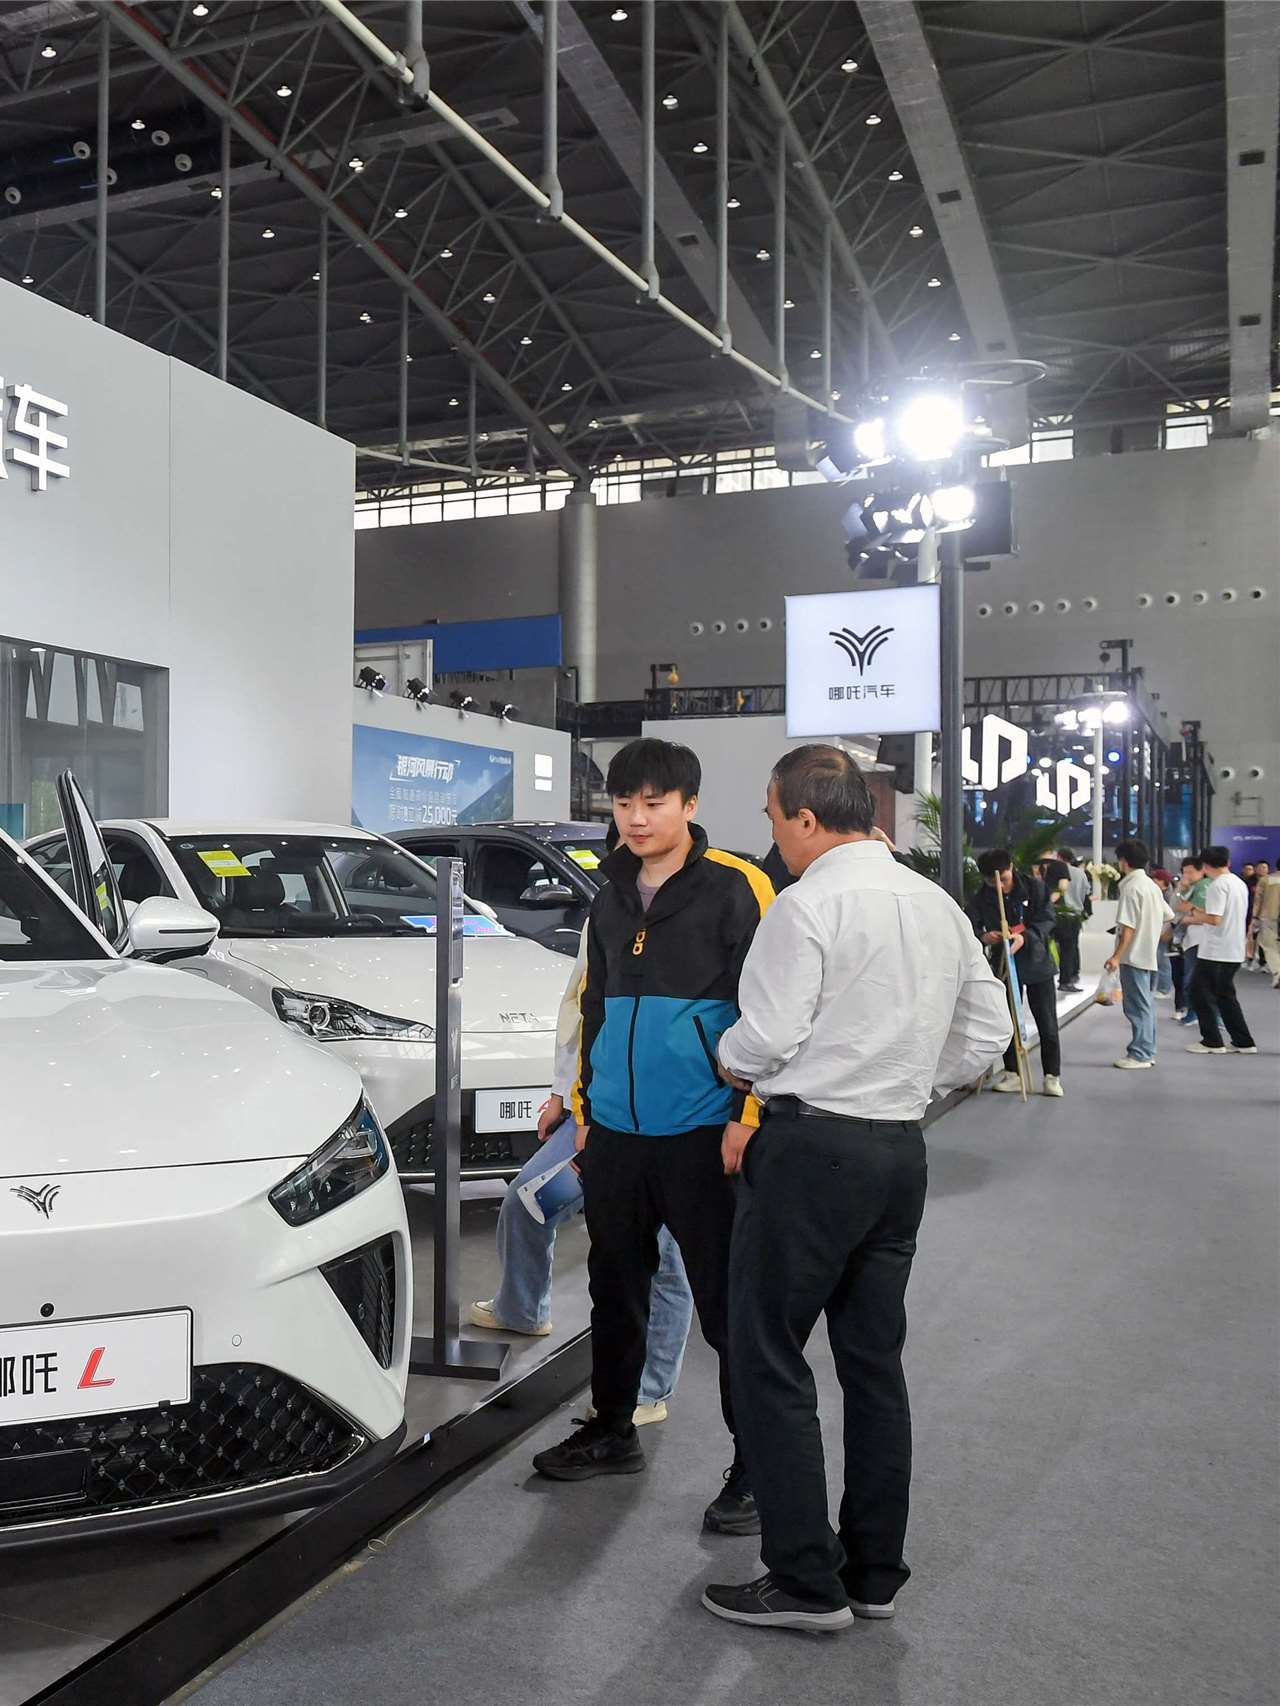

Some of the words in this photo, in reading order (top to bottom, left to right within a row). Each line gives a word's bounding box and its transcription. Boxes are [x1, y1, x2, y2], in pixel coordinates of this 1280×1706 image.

[828, 684, 895, 700] 哪吒汽车
[499, 1101, 533, 1120] 哪吒
[77, 1346, 116, 1390] L
